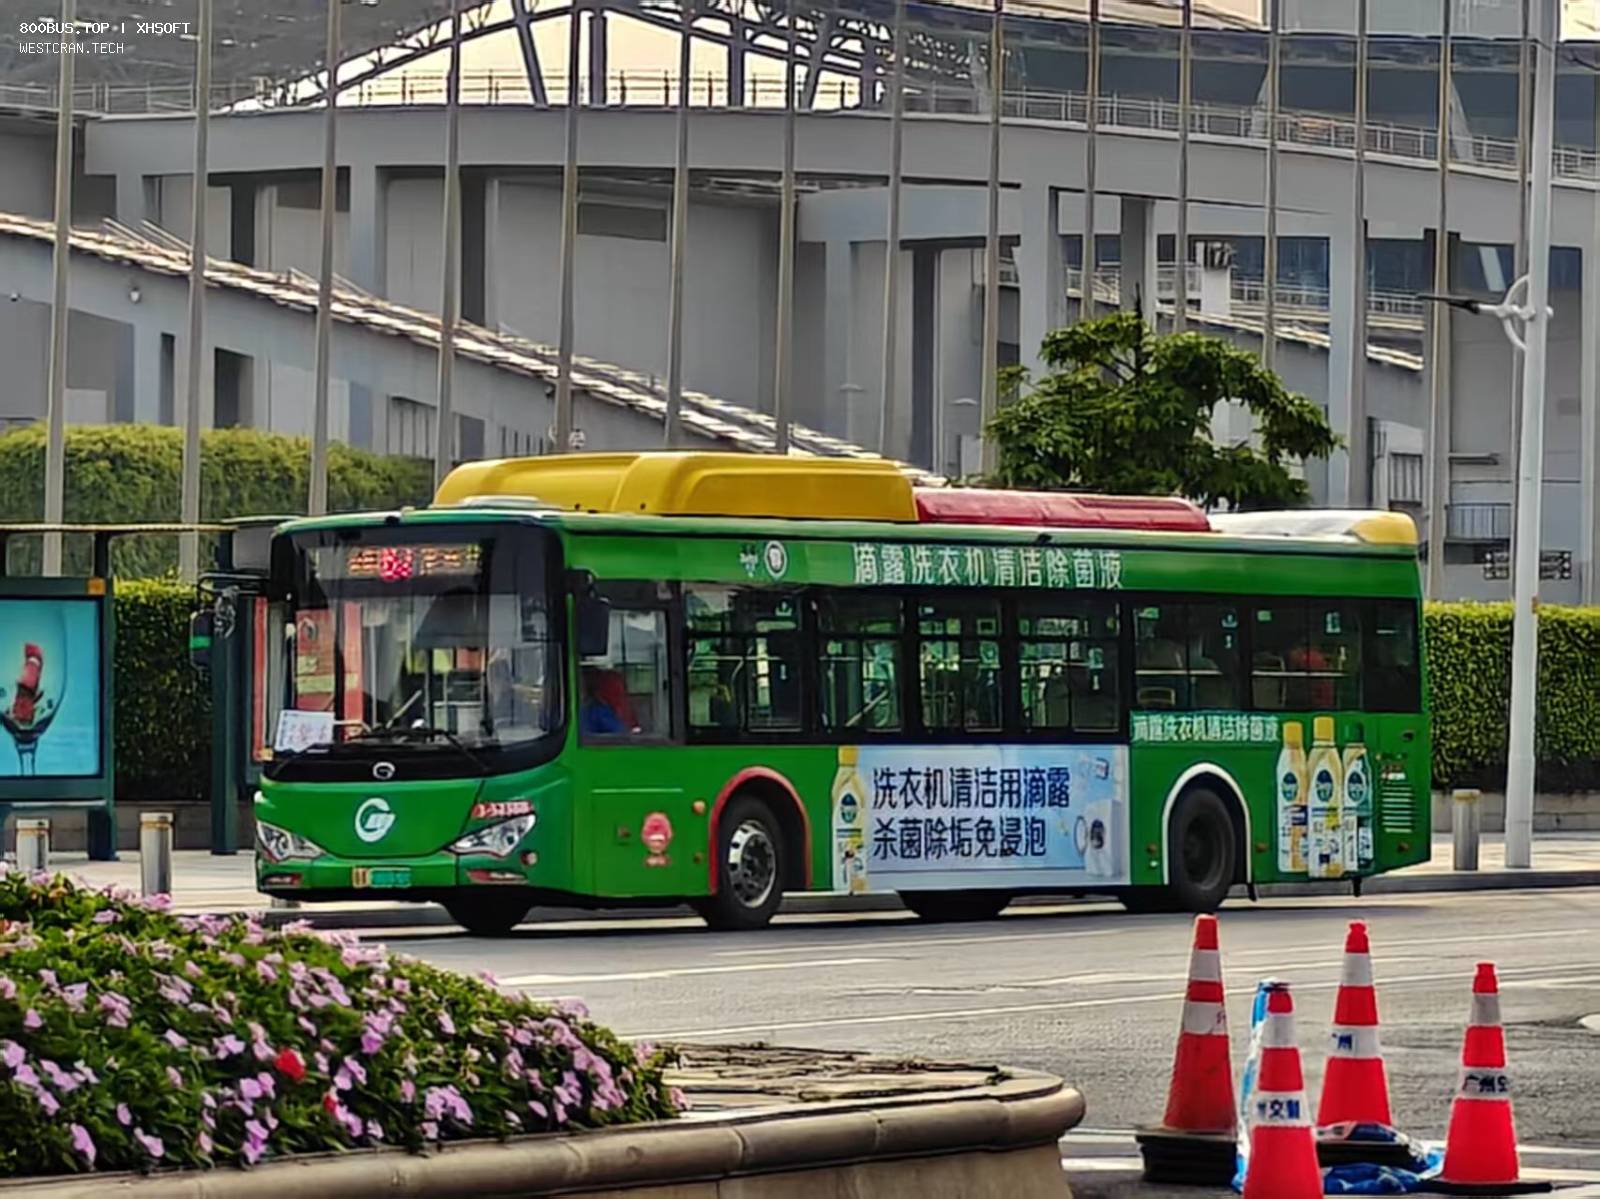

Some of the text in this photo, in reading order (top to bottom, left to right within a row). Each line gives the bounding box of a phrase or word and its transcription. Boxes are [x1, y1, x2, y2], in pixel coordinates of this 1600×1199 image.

[852, 541, 1124, 590] 滴露洗衣机清洁除菌液
[872, 766, 1071, 810] 洗衣机清洁用滴露
[872, 815, 1048, 861] 杀菌除垢免浸泡
